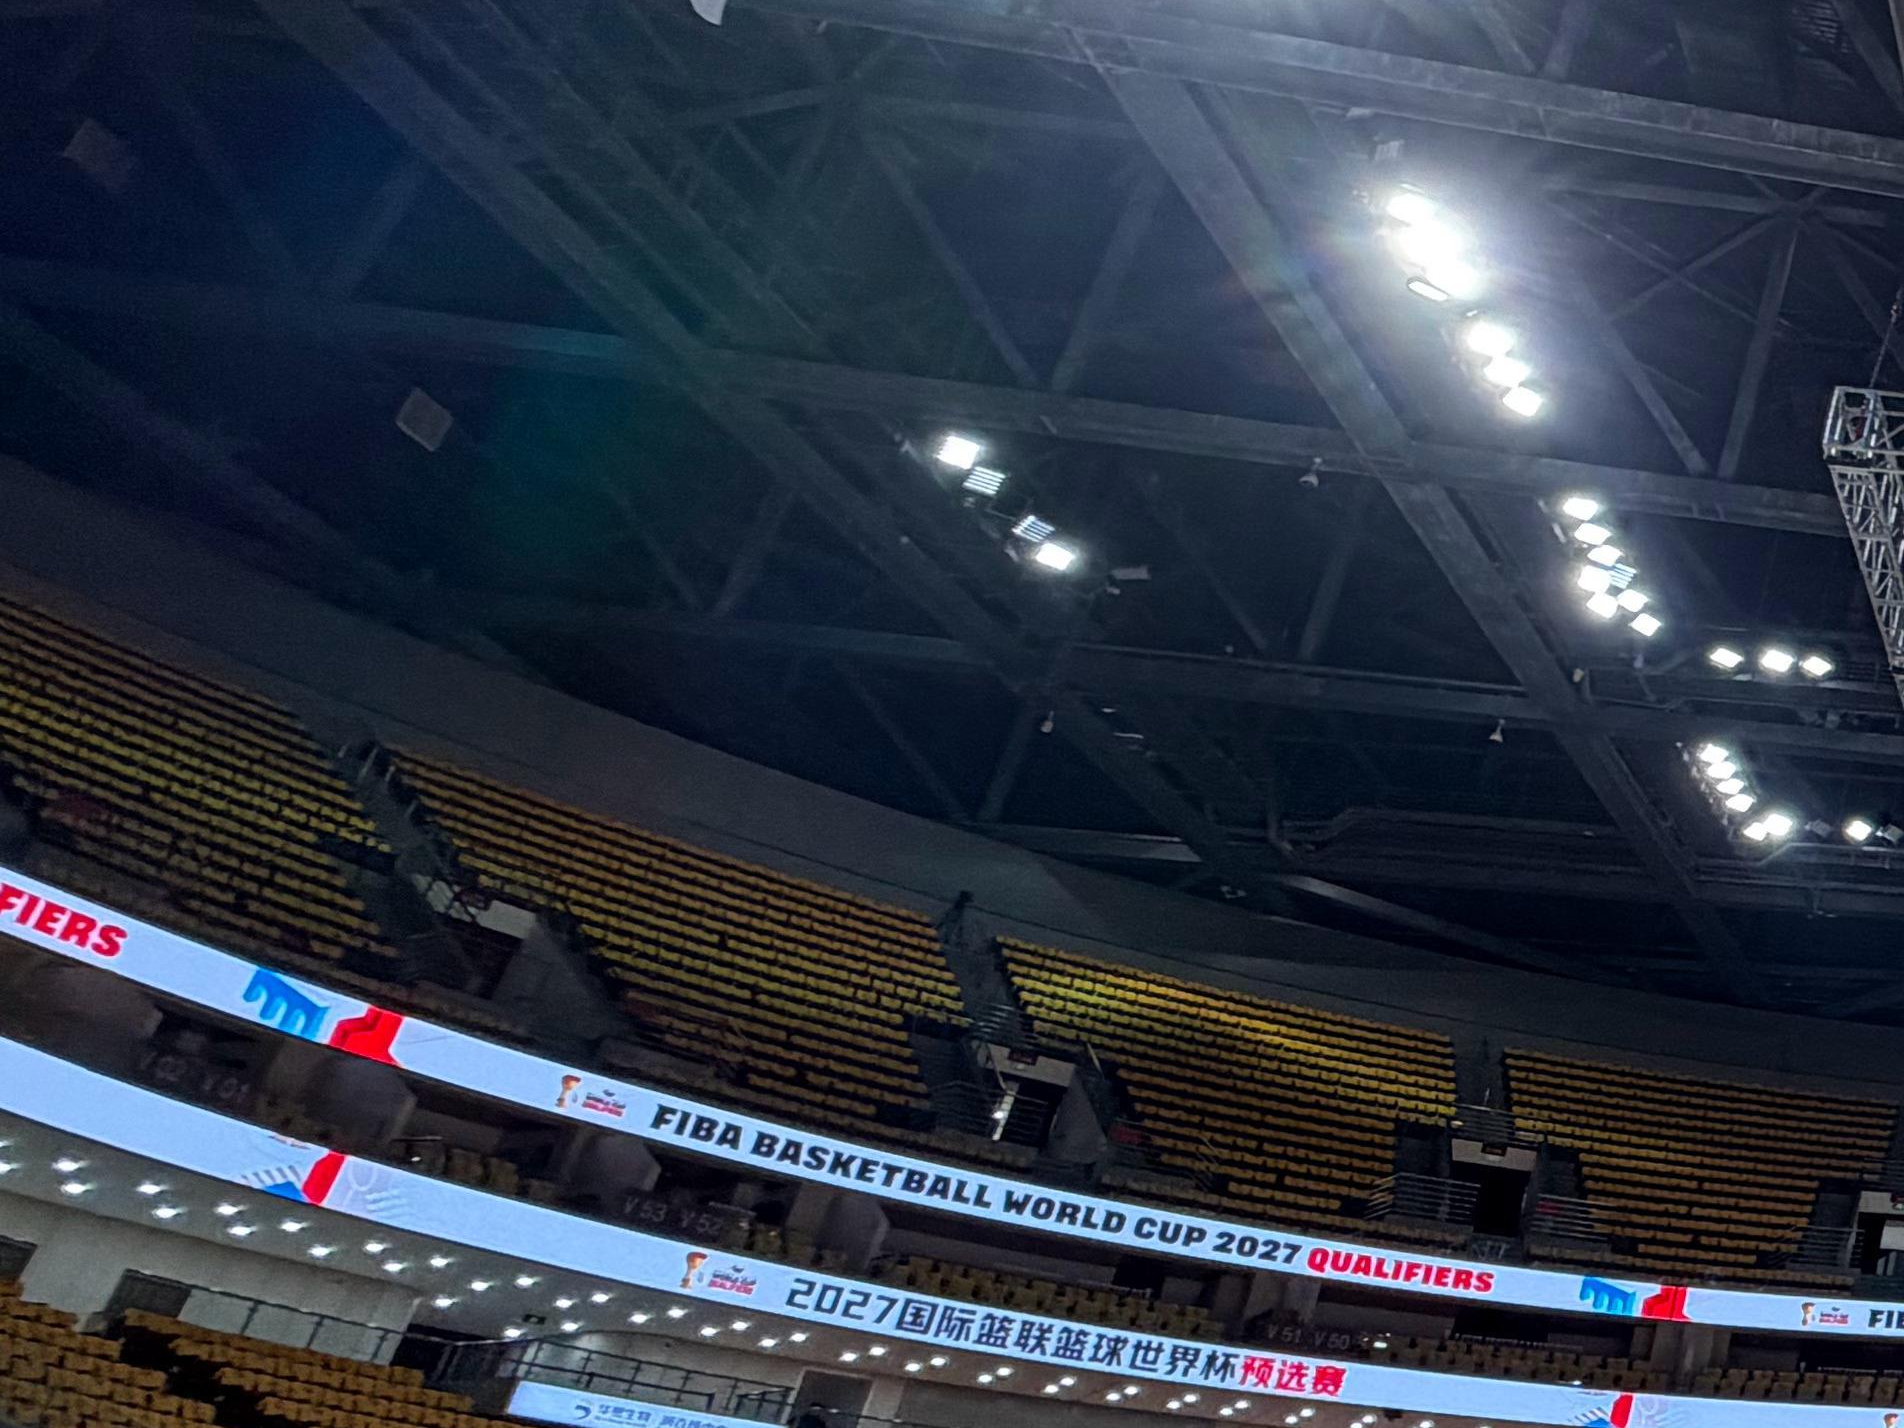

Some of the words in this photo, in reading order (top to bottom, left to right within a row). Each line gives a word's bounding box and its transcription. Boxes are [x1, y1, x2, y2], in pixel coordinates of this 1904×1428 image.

[650, 1104, 743, 1150] FIBA
[749, 1131, 992, 1209] BASKETBALL
[1002, 1189, 1127, 1234] WORLD
[1133, 1217, 1207, 1250] CUP
[1212, 1230, 1303, 1265] 2027
[1307, 1246, 1496, 1293] QUALIFIERS
[785, 1277, 1347, 1398] 2027国际篮联篮球世界杯预选赛
